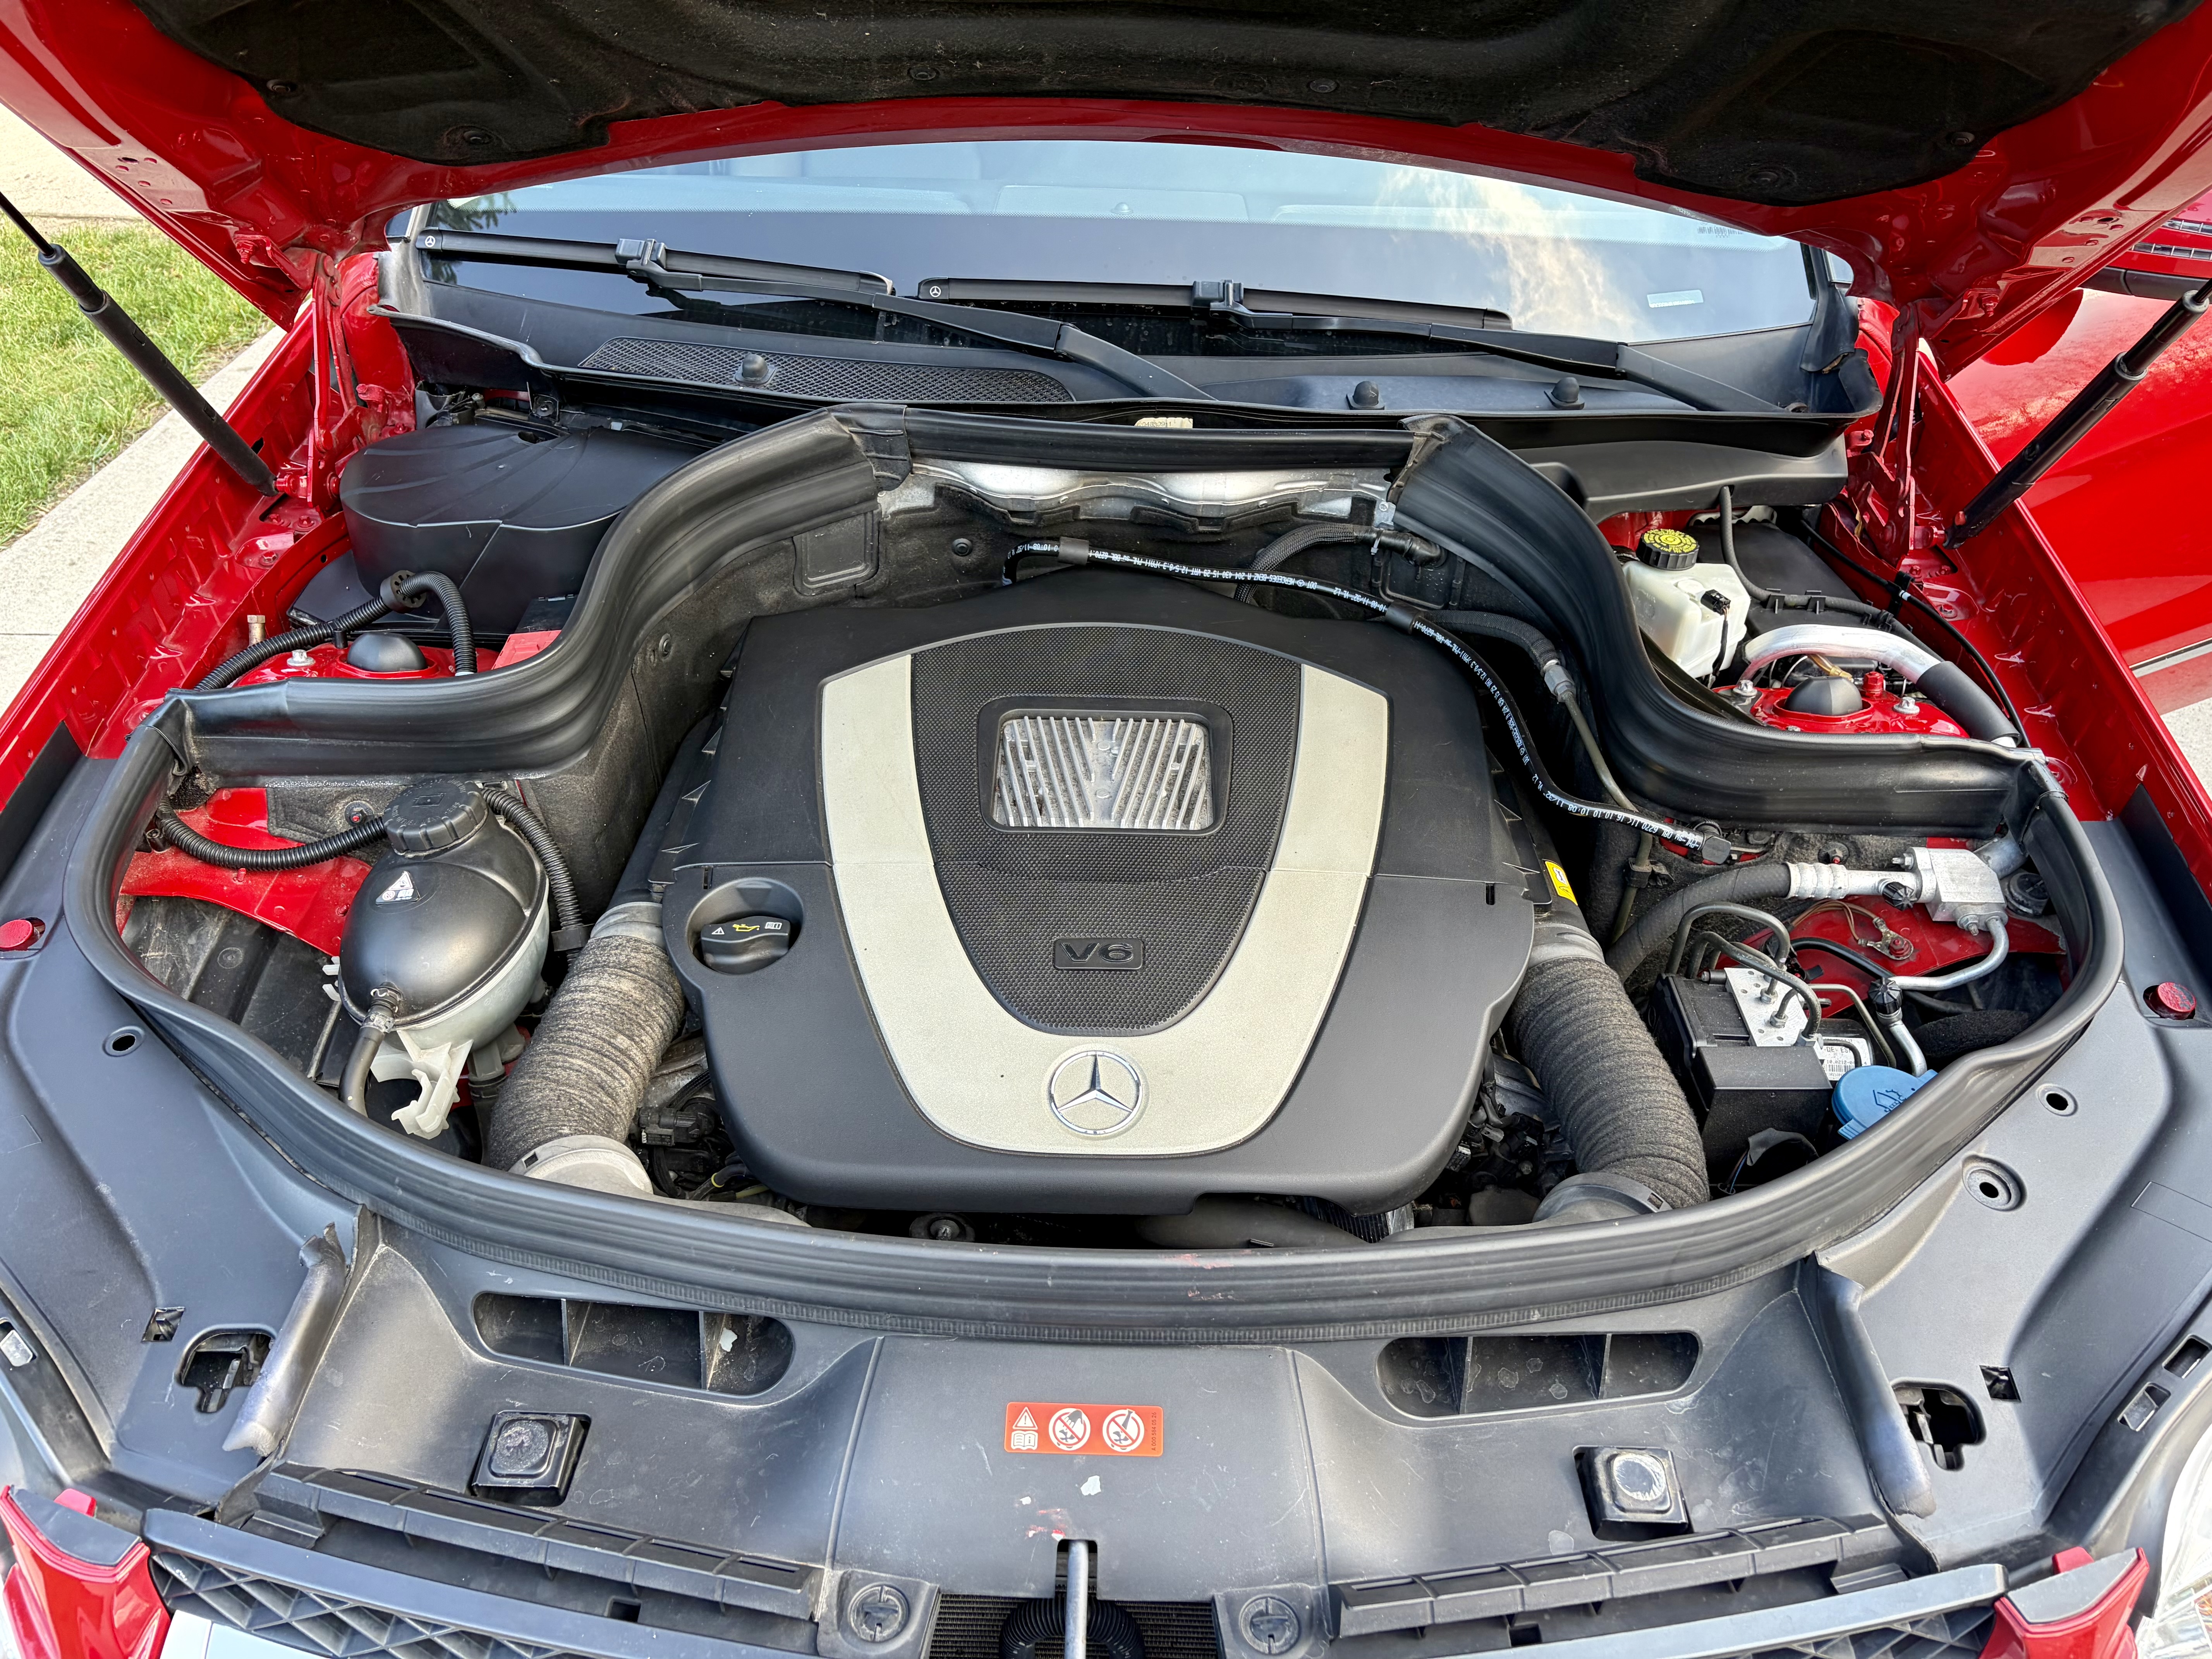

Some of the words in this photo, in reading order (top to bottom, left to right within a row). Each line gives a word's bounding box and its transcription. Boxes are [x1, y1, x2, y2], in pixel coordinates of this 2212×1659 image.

[1235, 572, 1245, 580] 204
[1306, 580, 1317, 589] DOT
[1568, 803, 1590, 816] 10:08
[1661, 828, 1674, 839] DBL
[1060, 942, 1134, 963] V6
